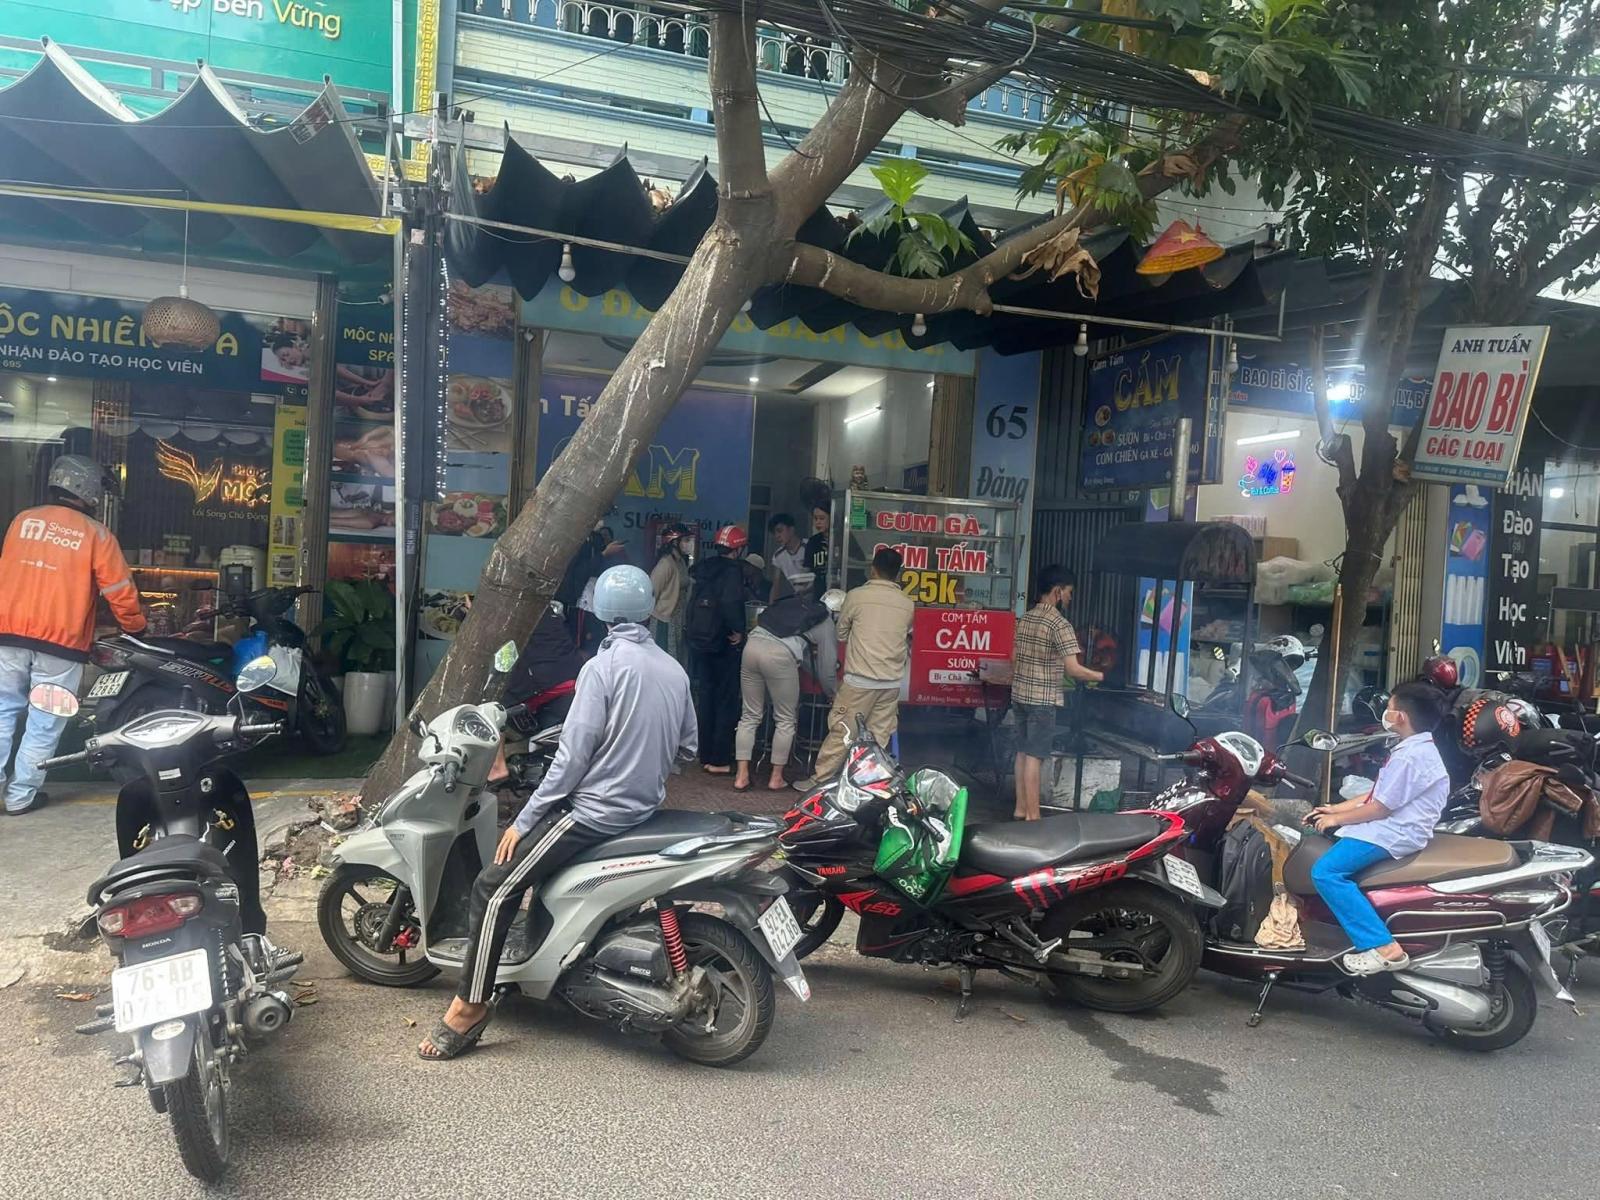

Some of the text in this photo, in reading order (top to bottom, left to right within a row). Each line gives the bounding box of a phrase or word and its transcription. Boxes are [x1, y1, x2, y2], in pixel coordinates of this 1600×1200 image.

[343, 327, 376, 343] MỘC
[1451, 333, 1532, 353] ANH TUẤN
[48, 348, 84, 363] ĐÀO
[89, 352, 122, 368] TẠO
[127, 356, 162, 372] HỌC
[167, 360, 203, 374] VIÊN
[1114, 350, 1181, 411] CÁM
[1241, 367, 1268, 386] BAO
[1427, 359, 1530, 436] BAO BÌ
[986, 404, 1028, 440] 65
[1426, 433, 1504, 465] CÁC LOẠI
[48, 521, 85, 539] Shopee
[876, 511, 937, 533] CƠM
[943, 514, 980, 536] GÀ
[1503, 509, 1533, 536] Đào
[43, 530, 82, 551] Food
[936, 541, 987, 574] TẤM
[1501, 553, 1529, 584] Tạo
[901, 570, 958, 604] 25k
[941, 612, 963, 623] CƠM
[1499, 596, 1527, 628] Học
[935, 625, 991, 651] CÁM
[947, 658, 976, 669] SƯỜN
[816, 865, 848, 875] YAMAHA
